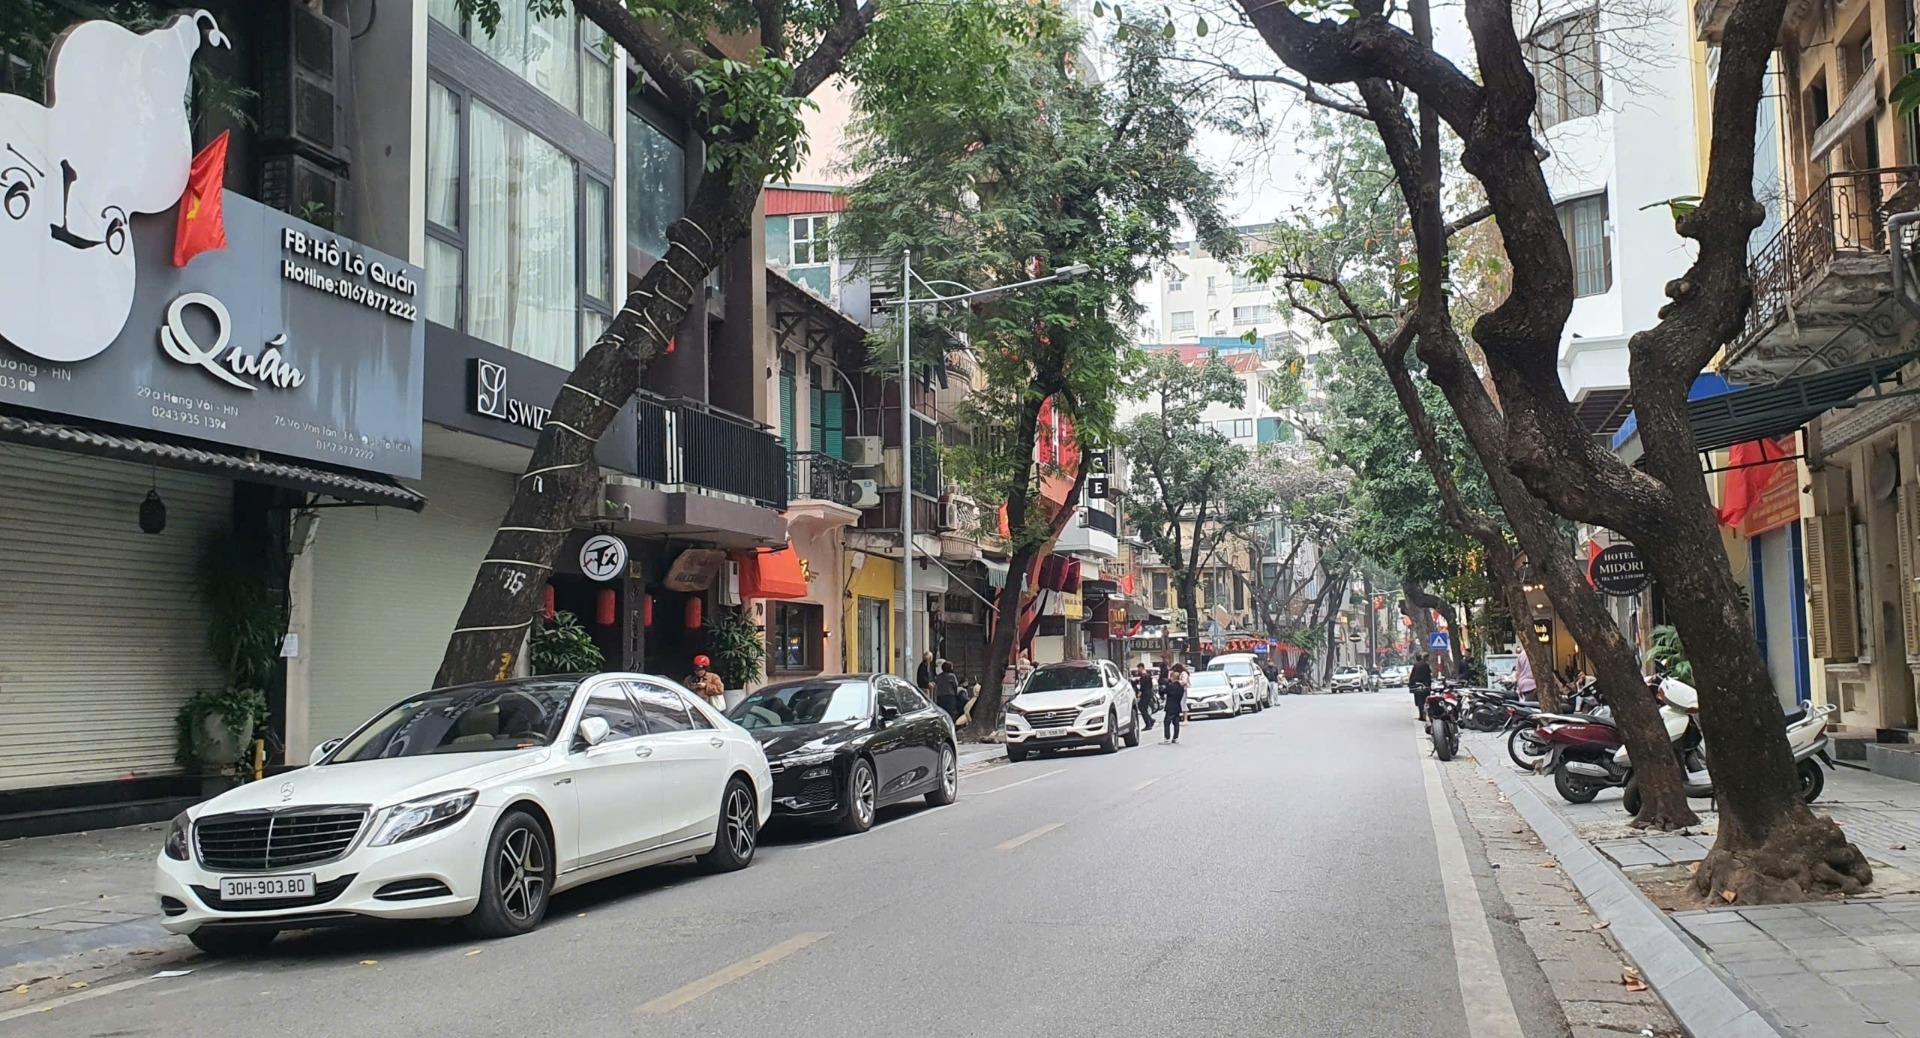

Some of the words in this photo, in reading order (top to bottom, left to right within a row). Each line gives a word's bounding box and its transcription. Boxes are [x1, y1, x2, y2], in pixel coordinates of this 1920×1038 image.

[345, 251, 365, 276] Lô
[370, 262, 417, 296] Quán
[161, 292, 305, 391] Quán
[52, 368, 71, 381] HN
[223, 405, 239, 416] HN
[180, 412, 200, 425] 935
[204, 417, 227, 430] 1394
[1604, 551, 1636, 562] HOTEL
[1599, 561, 1644, 575] MIDORI
[755, 602, 763, 616] 70
[228, 878, 305, 896] 30H-903.80
